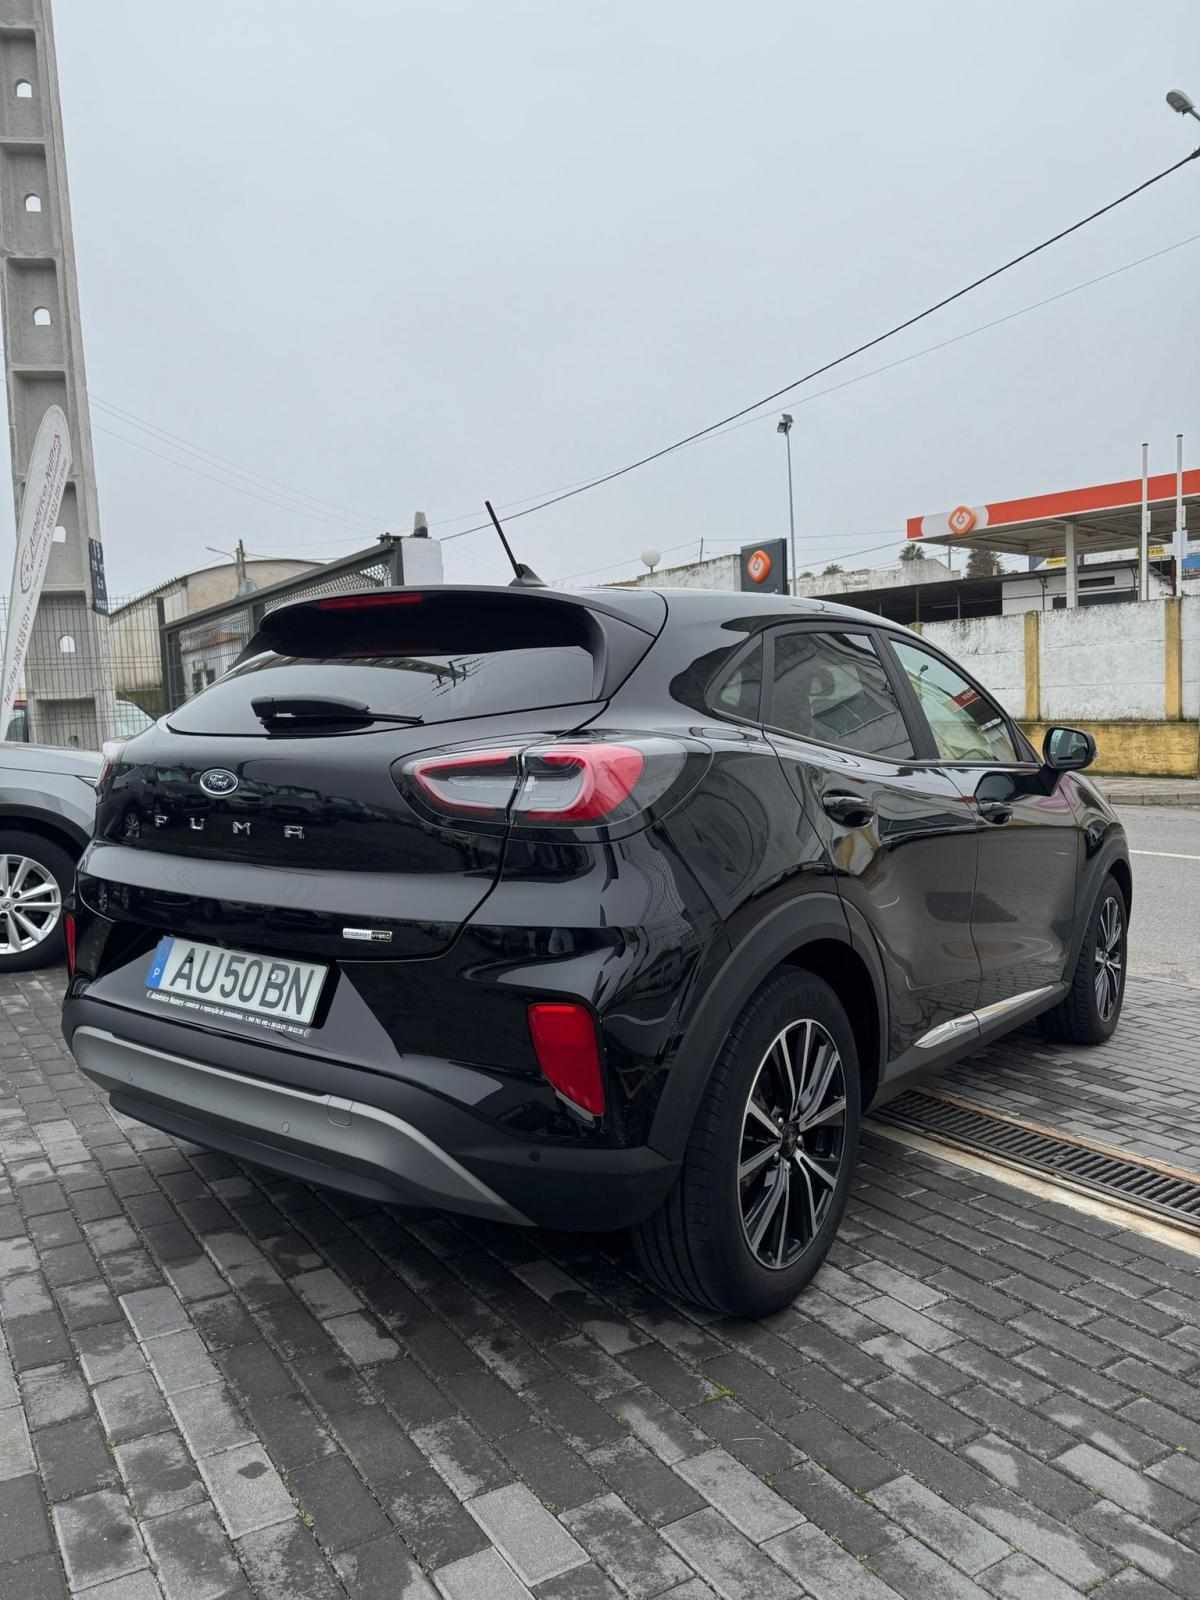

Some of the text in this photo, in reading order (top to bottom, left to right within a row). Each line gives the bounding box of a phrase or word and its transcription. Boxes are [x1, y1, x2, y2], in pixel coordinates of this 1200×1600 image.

[154, 815, 304, 839] PUMA
[152, 968, 161, 979] P
[170, 947, 314, 1015] AU50BN
